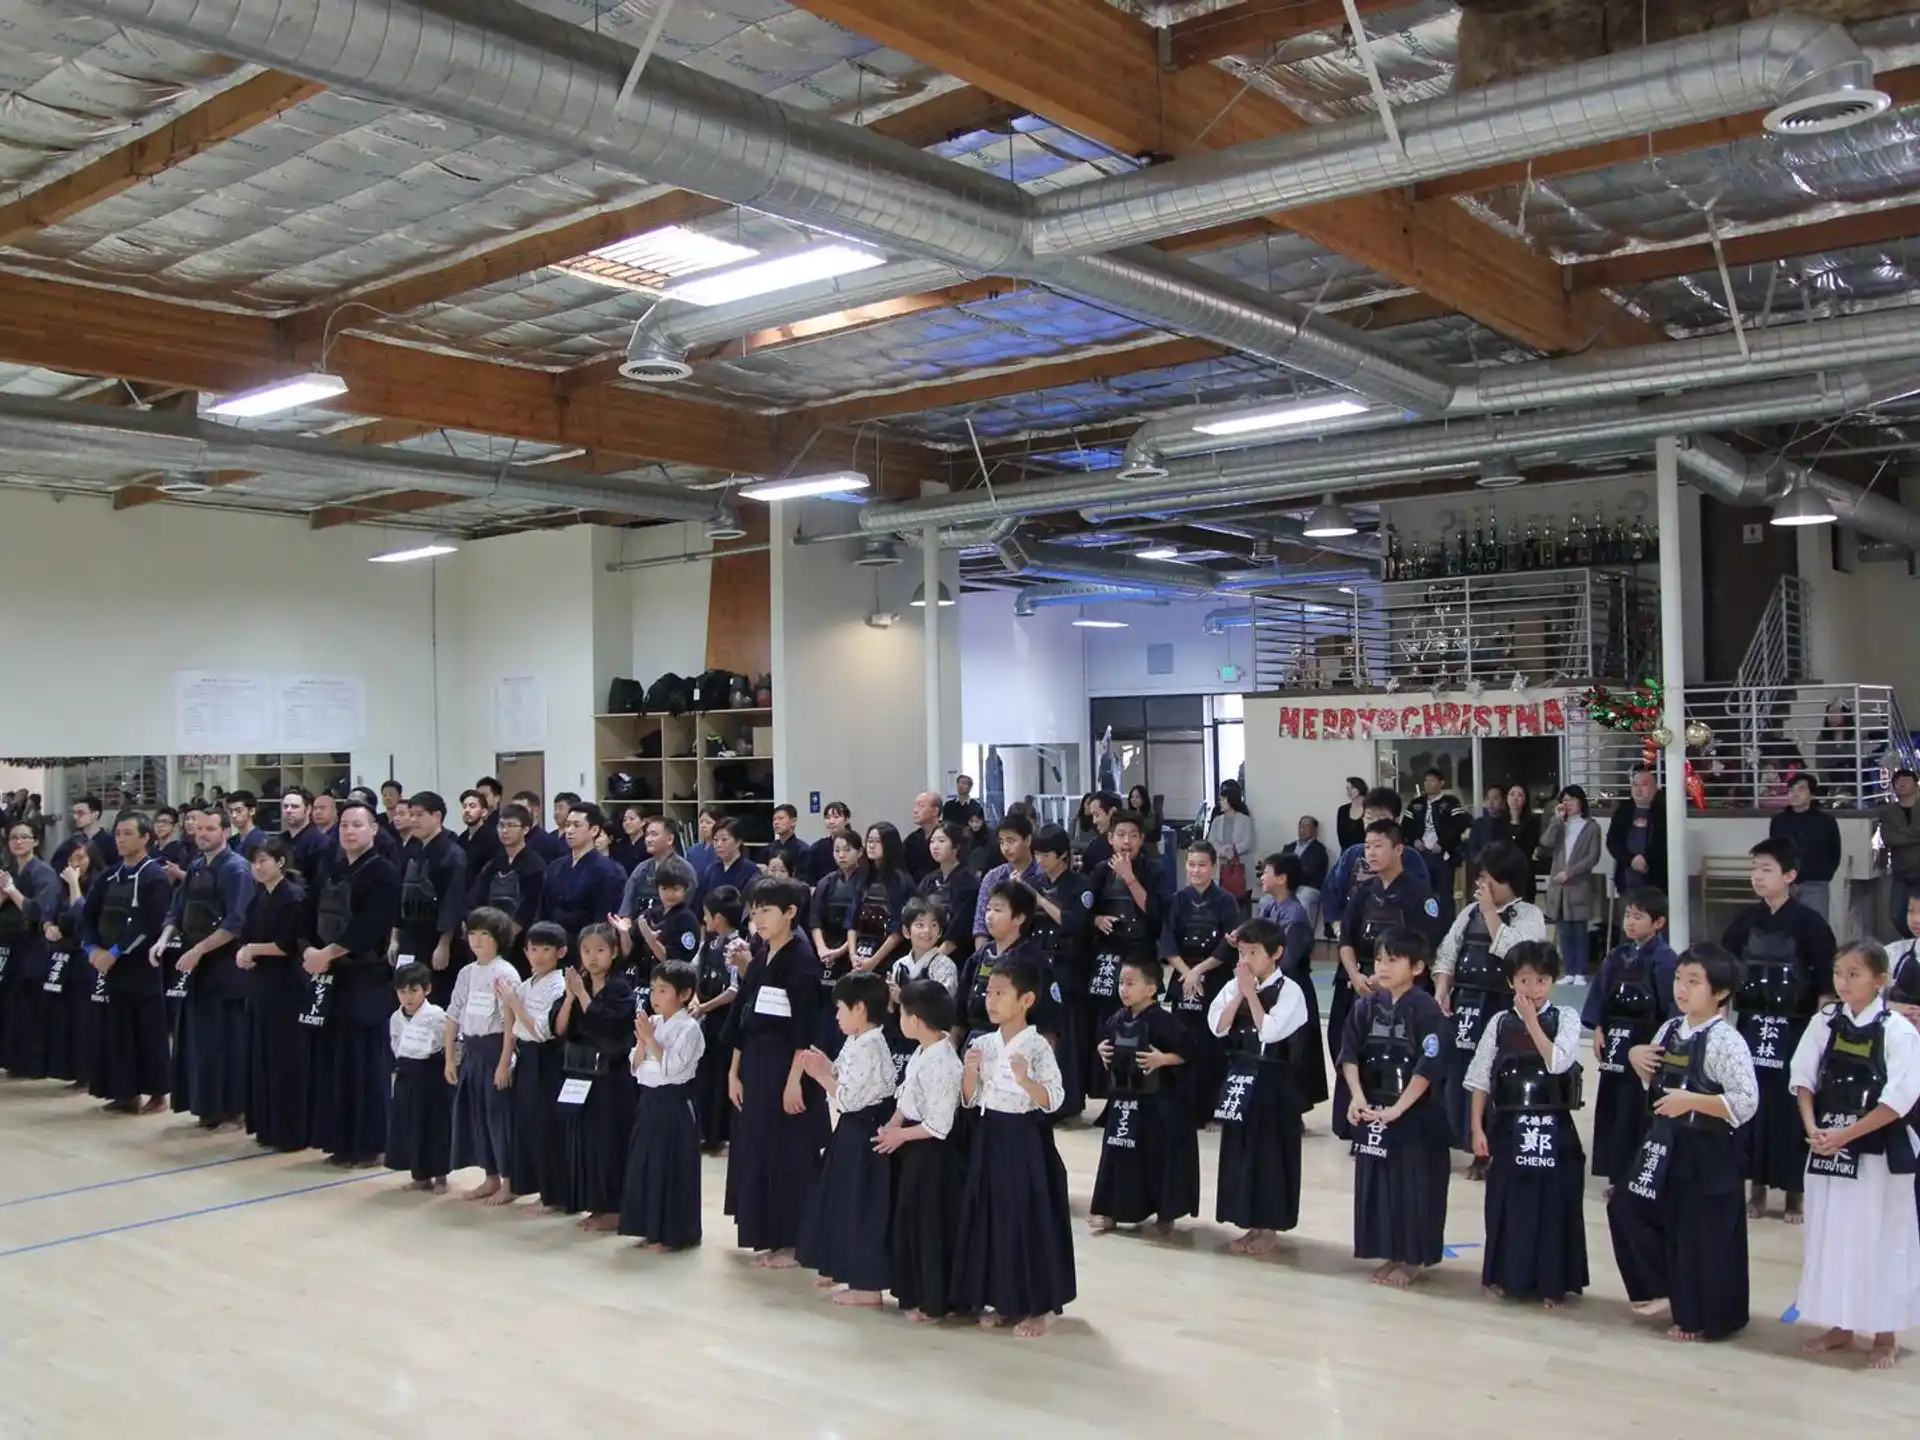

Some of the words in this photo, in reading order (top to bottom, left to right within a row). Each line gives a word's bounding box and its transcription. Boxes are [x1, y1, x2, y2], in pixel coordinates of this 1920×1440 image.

[1279, 706, 1378, 741] MERRY
[1758, 1022, 1779, 1057] 松林
[1221, 1083, 1245, 1111] 井村
[1116, 1110, 1130, 1138] ヌエン
[1515, 1155, 1556, 1167] CHENG
[1637, 1153, 1660, 1188] 酒井
